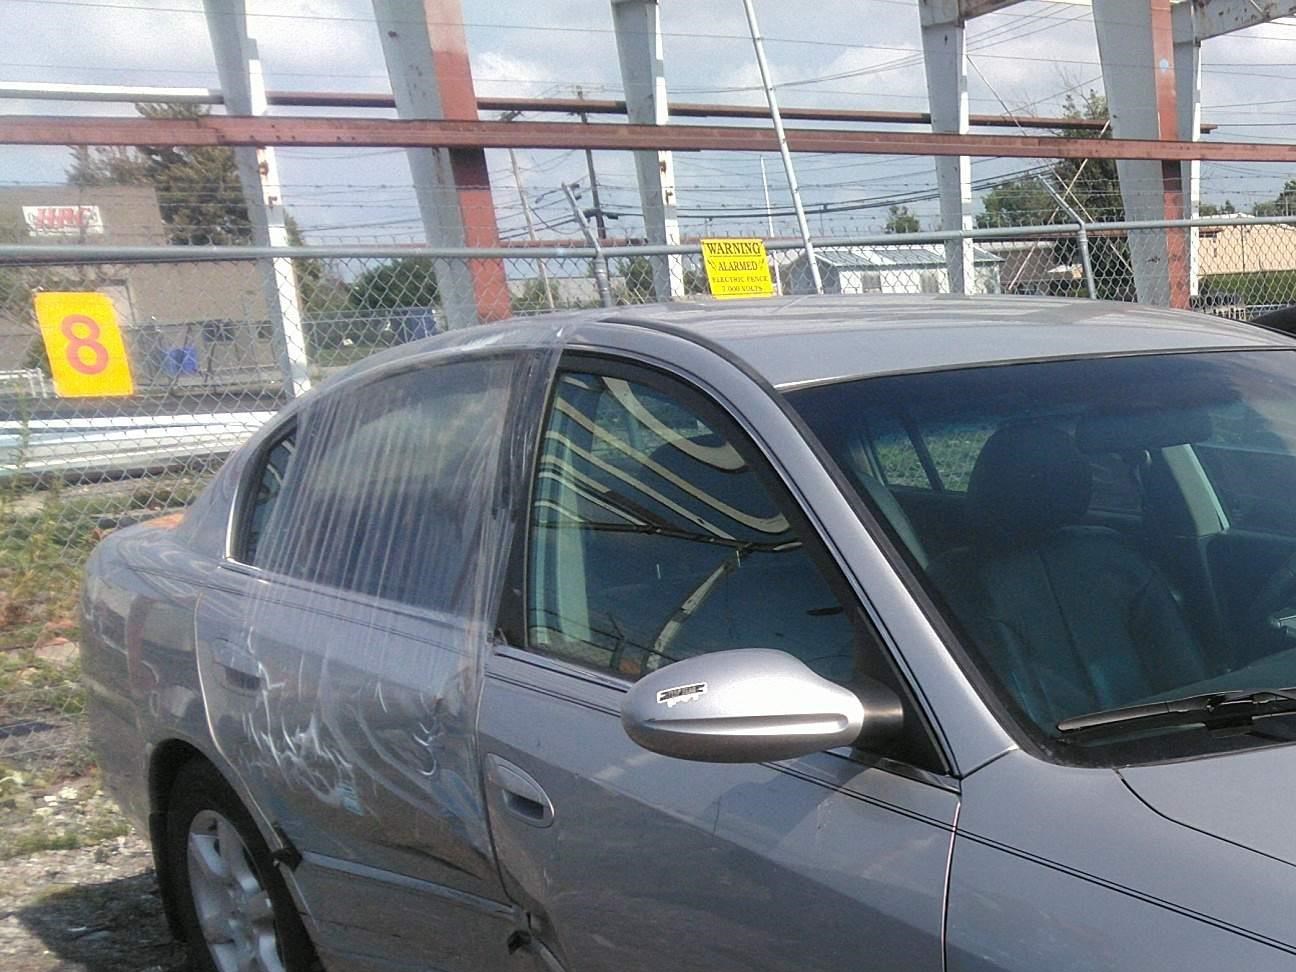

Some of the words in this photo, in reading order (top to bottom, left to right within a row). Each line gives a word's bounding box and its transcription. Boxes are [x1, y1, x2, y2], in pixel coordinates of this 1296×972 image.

[706, 243, 761, 255] WARNING
[719, 261, 758, 271] ALARMED
[61, 314, 109, 375] 8
